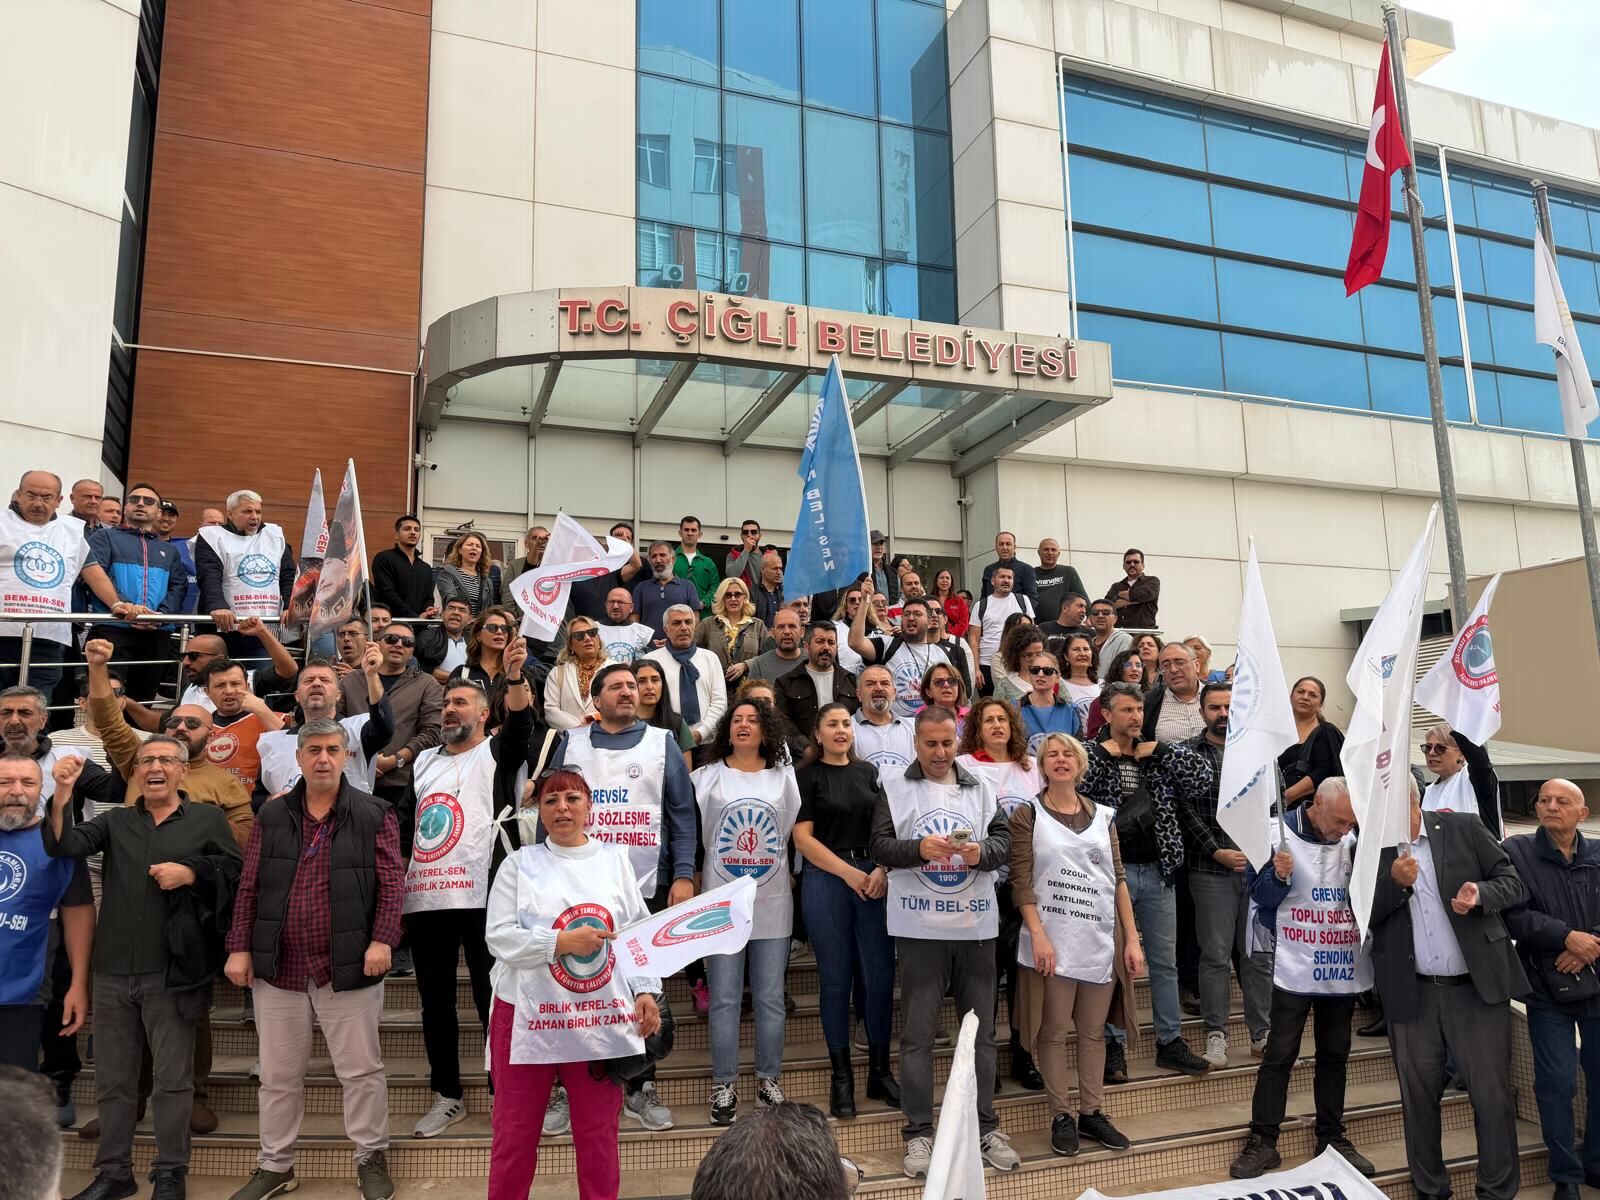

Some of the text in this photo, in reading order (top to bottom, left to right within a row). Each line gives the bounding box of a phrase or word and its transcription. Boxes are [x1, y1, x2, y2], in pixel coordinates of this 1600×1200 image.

[559, 294, 1079, 378] T.C. ÇİĞLİ BELEDİYESİ
[592, 785, 629, 803] REVSİZ
[598, 808, 651, 828] SÖZLEŞME
[721, 855, 774, 865] TÜM BEL-SEN
[419, 865, 466, 880] YEREL-SEN
[413, 880, 438, 893] BİRLİK
[440, 879, 474, 890] ZAMANI
[900, 895, 991, 913] TÜM BEL-SEN
[1041, 904, 1067, 916] YEREL
[1291, 907, 1324, 924] TOPLU
[1282, 926, 1316, 944] TOPLU
[1313, 948, 1354, 965] SENDİKA
[1313, 967, 1354, 981] OLMAZ
[539, 1001, 572, 1014] BİRLİK
[528, 1020, 565, 1031] ZAMAN
[567, 1015, 601, 1029] BİRLİK
